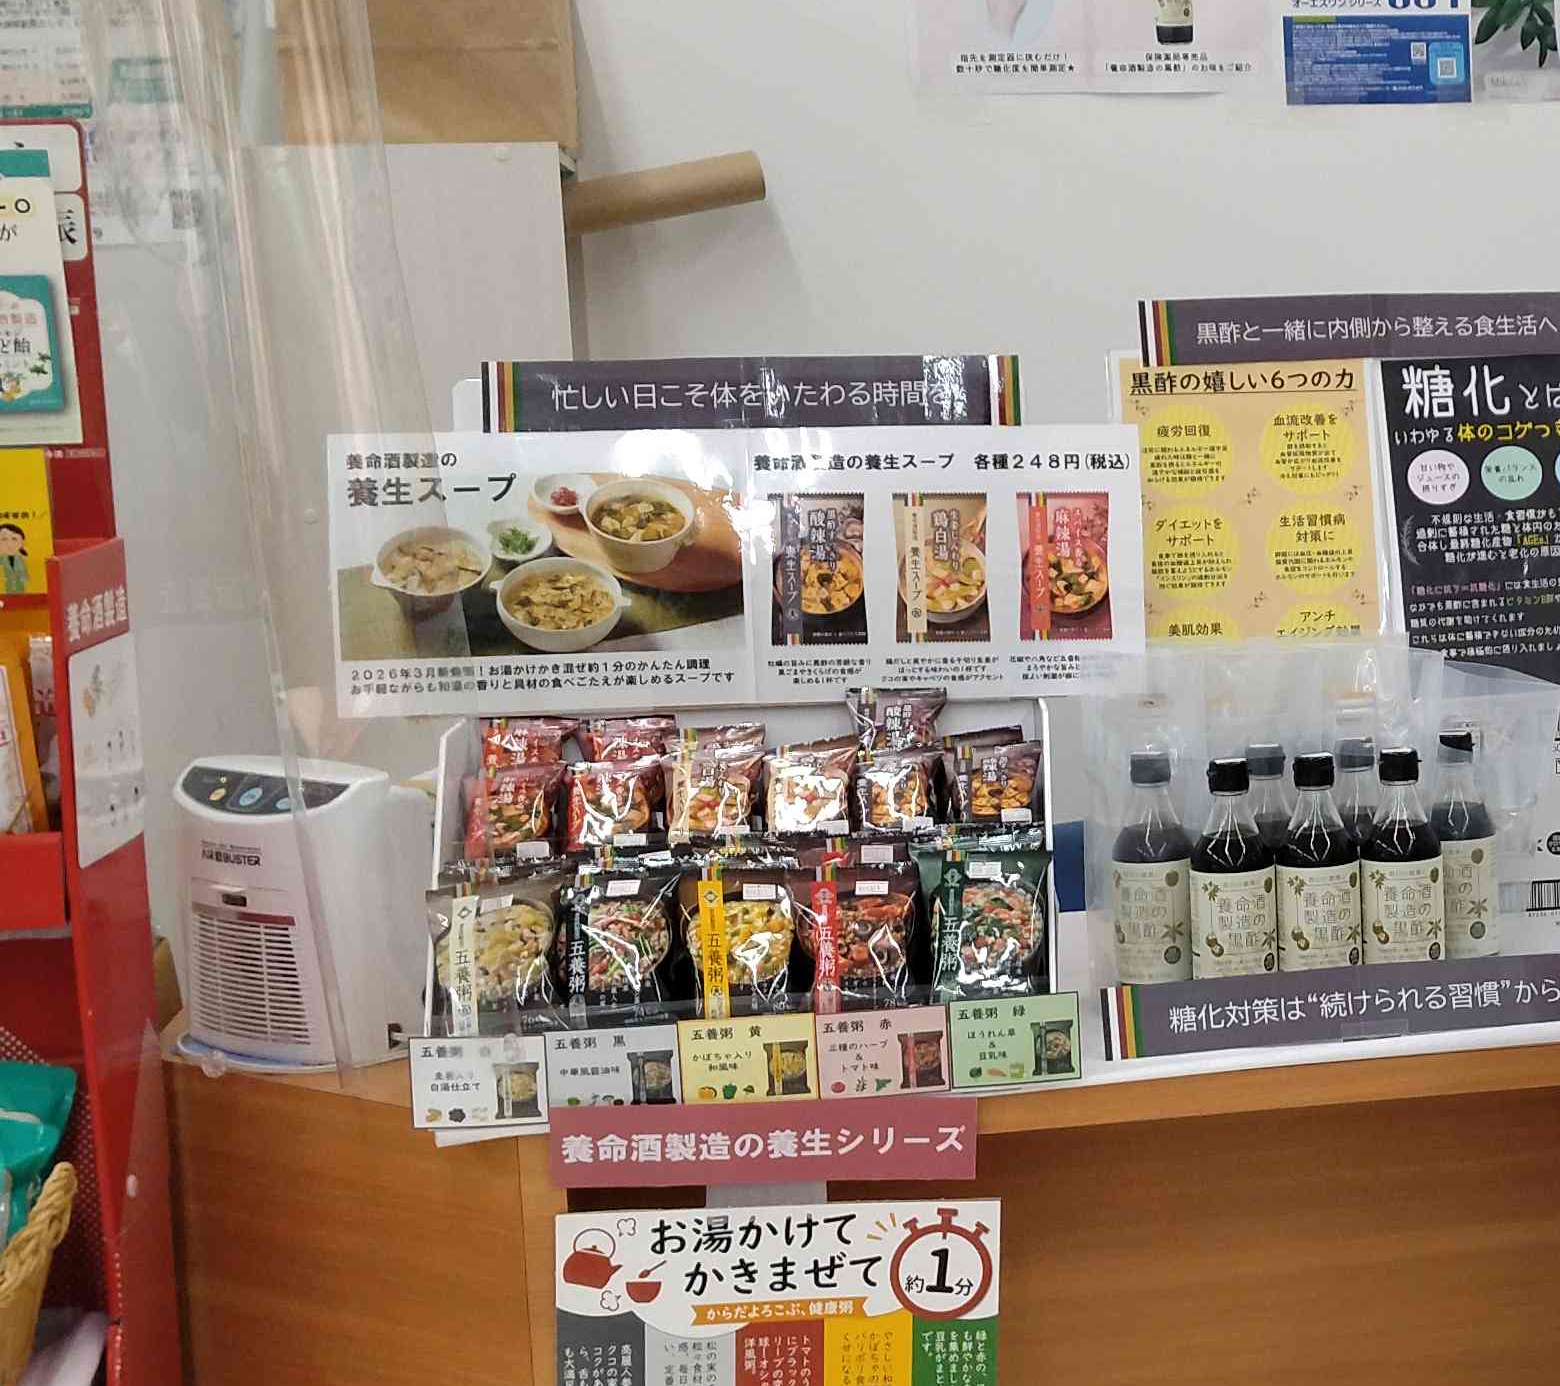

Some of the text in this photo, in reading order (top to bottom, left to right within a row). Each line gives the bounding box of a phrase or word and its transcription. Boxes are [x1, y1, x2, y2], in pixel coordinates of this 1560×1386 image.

[1196, 315, 1559, 345] 黒酢と一緒に内側から整える食生活へ
[1129, 368, 1355, 395] 黒酢の嬉しい6つの力
[1273, 413, 1338, 426] 血流改善を
[1156, 424, 1212, 438] 疲労回復
[1282, 429, 1331, 442] サポート
[346, 451, 458, 471] 養命酒製造の
[346, 472, 518, 508] 養生スープ
[1155, 517, 1223, 532] ダイエットを
[1279, 513, 1346, 527] 生活習慣病
[932, 508, 949, 562] 鶏白湯
[1166, 535, 1215, 547] サポート
[1296, 530, 1334, 543] 対策に
[66, 584, 128, 643] 養命酒製造
[1299, 610, 1336, 622] アンチ
[1168, 622, 1223, 636] 美肌効果
[817, 925, 836, 980] 五養粥
[941, 917, 960, 972] 五養粥
[707, 933, 724, 982] 五養粥
[568, 940, 586, 994] 五養粥
[957, 1004, 1026, 1021] 五養粥 緑
[691, 1025, 763, 1042] 五養粥 黄
[823, 1018, 892, 1034] 五養粥 赤
[553, 1036, 627, 1051] 五養粥 黒
[692, 1050, 753, 1062] かぼちゃ入り
[708, 1061, 739, 1072] 和風味
[841, 1063, 880, 1074] トマト味
[561, 1125, 966, 1165] 養命酒製造の養生シリーズ
[649, 1212, 859, 1255] お湯かけて
[683, 1253, 883, 1296] かきまぜて
[706, 1301, 855, 1321] からだよろこぶ、健康粥
